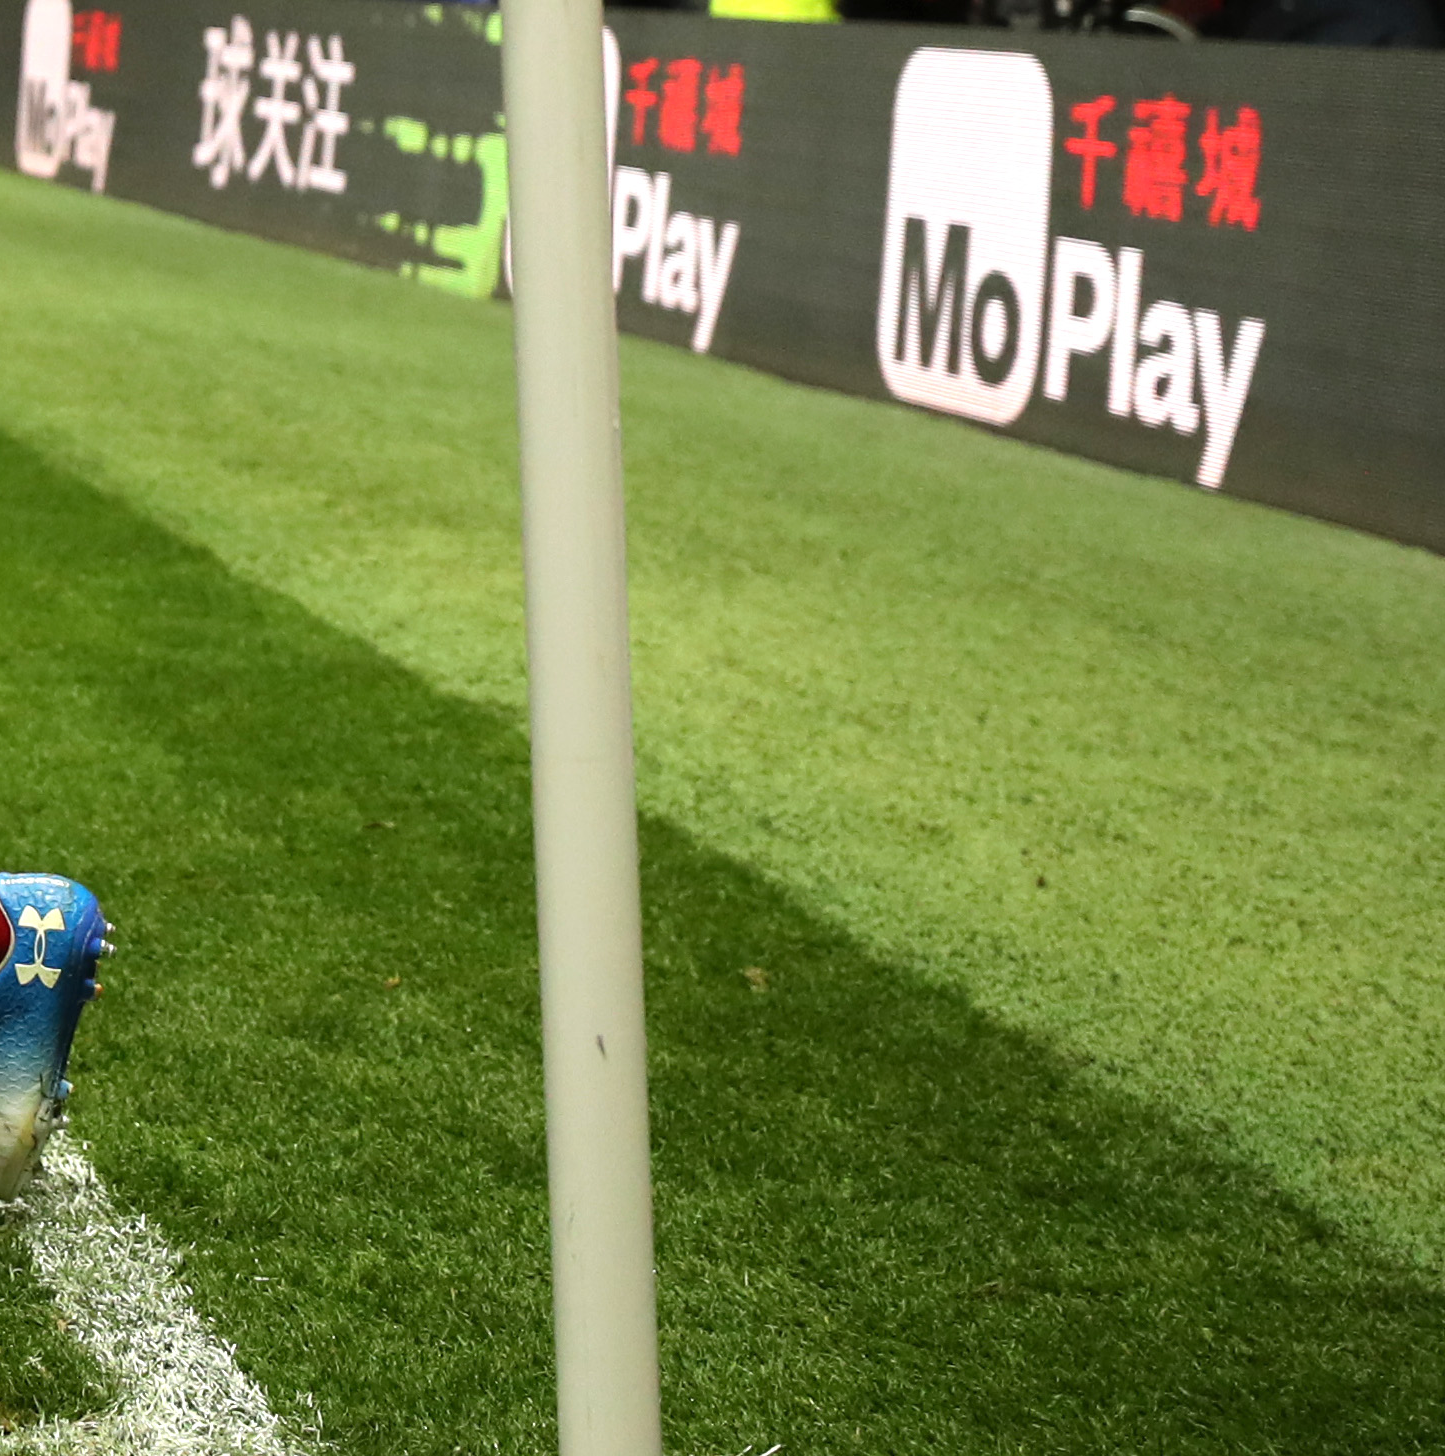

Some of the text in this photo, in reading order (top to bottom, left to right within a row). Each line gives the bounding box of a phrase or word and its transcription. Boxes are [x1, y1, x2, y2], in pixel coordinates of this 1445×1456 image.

[192, 12, 357, 193] 球关注
[895, 216, 1267, 489] MoPlay
